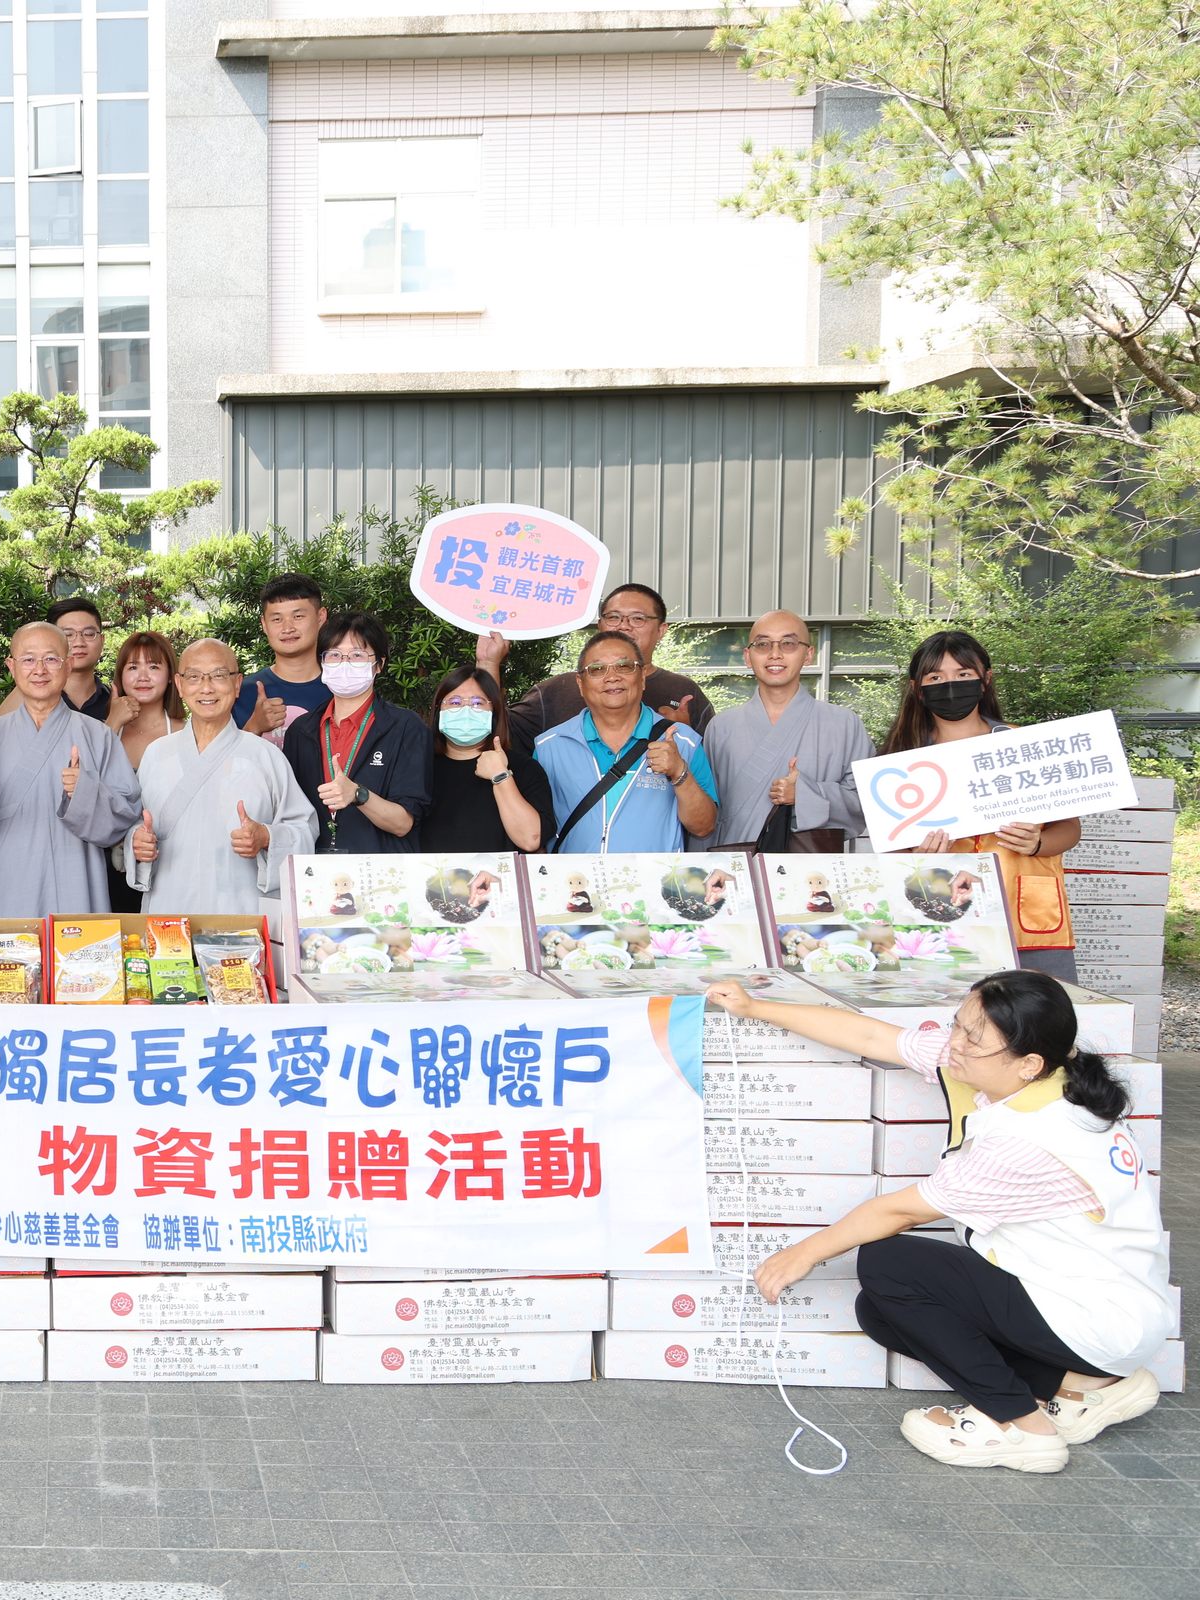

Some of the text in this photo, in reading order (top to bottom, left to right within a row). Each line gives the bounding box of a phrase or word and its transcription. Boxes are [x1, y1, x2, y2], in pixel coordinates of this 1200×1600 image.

[433, 536, 489, 590] 投
[497, 546, 585, 579] 觀光首都
[490, 575, 577, 606] 宜居城市
[971, 733, 1093, 773] 南投縣政府
[967, 754, 1114, 800] 社會及勞動局
[972, 779, 1119, 813] Social and Labor Affairs Bureau,
[984, 790, 1112, 821] Nantou County Government
[37, 1125, 601, 1200] 物資捐贈活動
[143, 1213, 368, 1253] 協辦單位：南投縣政府
